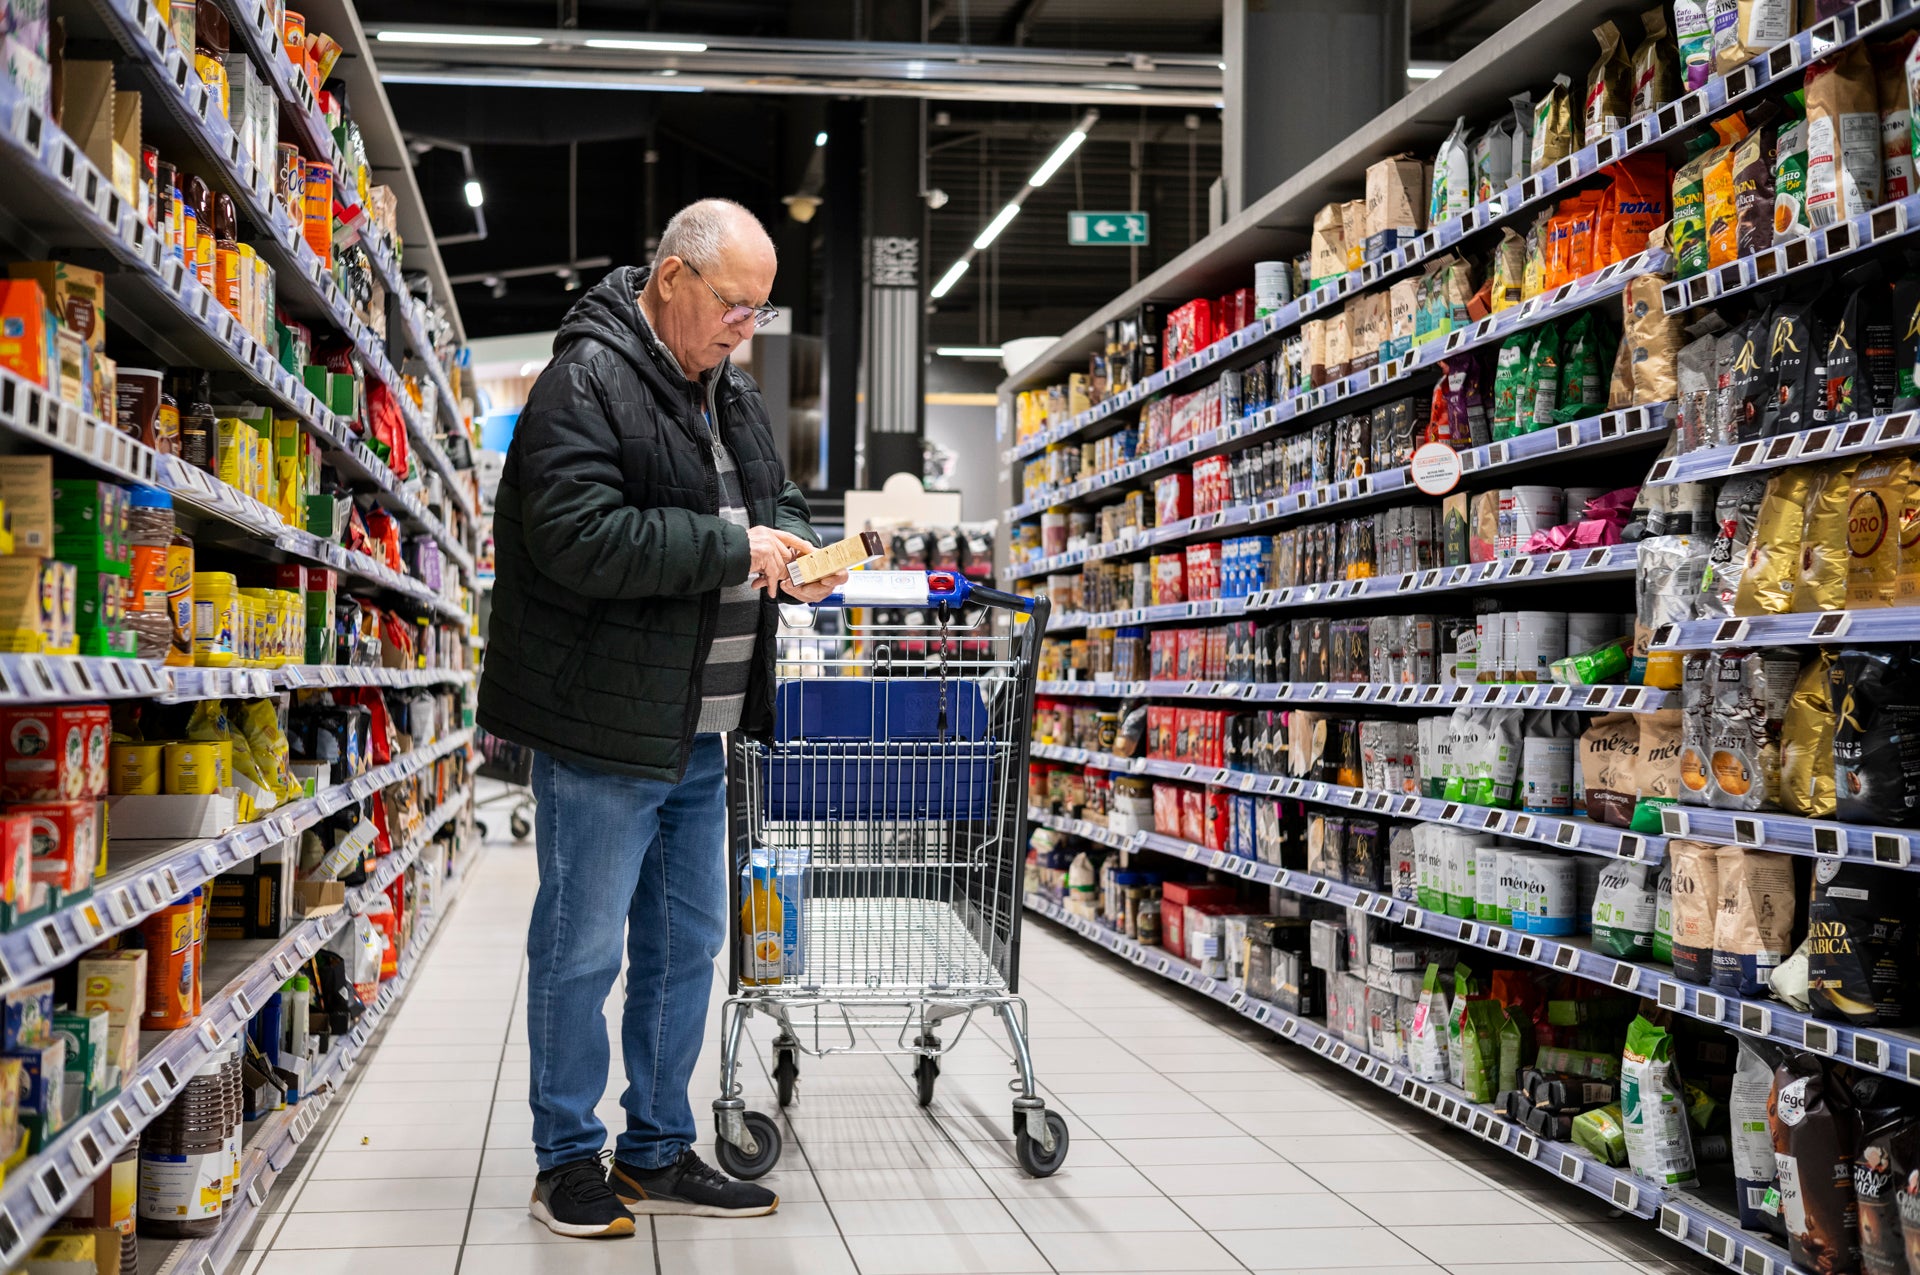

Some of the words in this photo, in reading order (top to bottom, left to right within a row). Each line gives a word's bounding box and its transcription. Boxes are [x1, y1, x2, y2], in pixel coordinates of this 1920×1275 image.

[1618, 201, 1662, 215] TOTAL
[885, 237, 900, 285] INFO
[900, 238, 919, 285] PRIX
[1850, 516, 1879, 534] ORO
